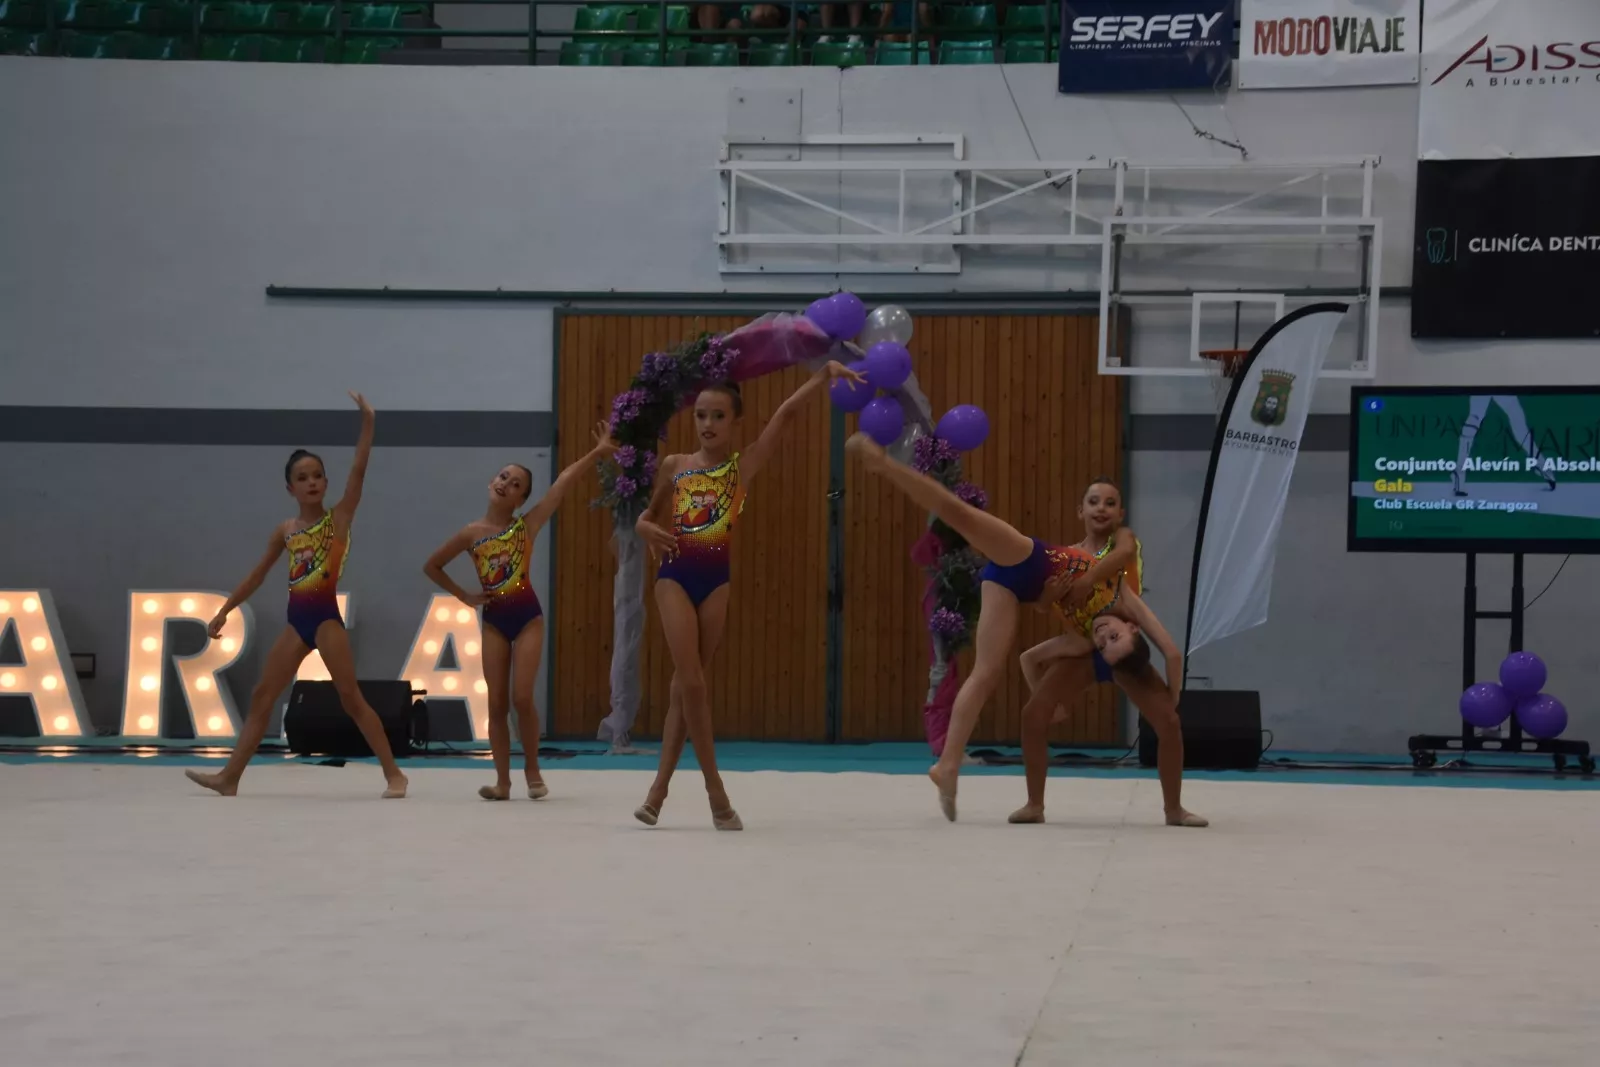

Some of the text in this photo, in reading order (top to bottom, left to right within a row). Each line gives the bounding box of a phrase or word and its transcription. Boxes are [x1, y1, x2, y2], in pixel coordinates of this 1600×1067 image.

[1070, 12, 1223, 42] SERFEY
[1466, 74, 1580, 87] A Bluestar
[1468, 233, 1600, 252] CLINÍCA DENT
[1371, 401, 1377, 410] 6
[1226, 429, 1297, 450] BARBASTRO
[1375, 457, 1457, 475] Conjunto
[1462, 457, 1520, 471] Alevín
[1525, 457, 1538, 471] P
[1374, 478, 1413, 493] Gala
[1374, 499, 1538, 513] Club Escuela GR Zaragoza
